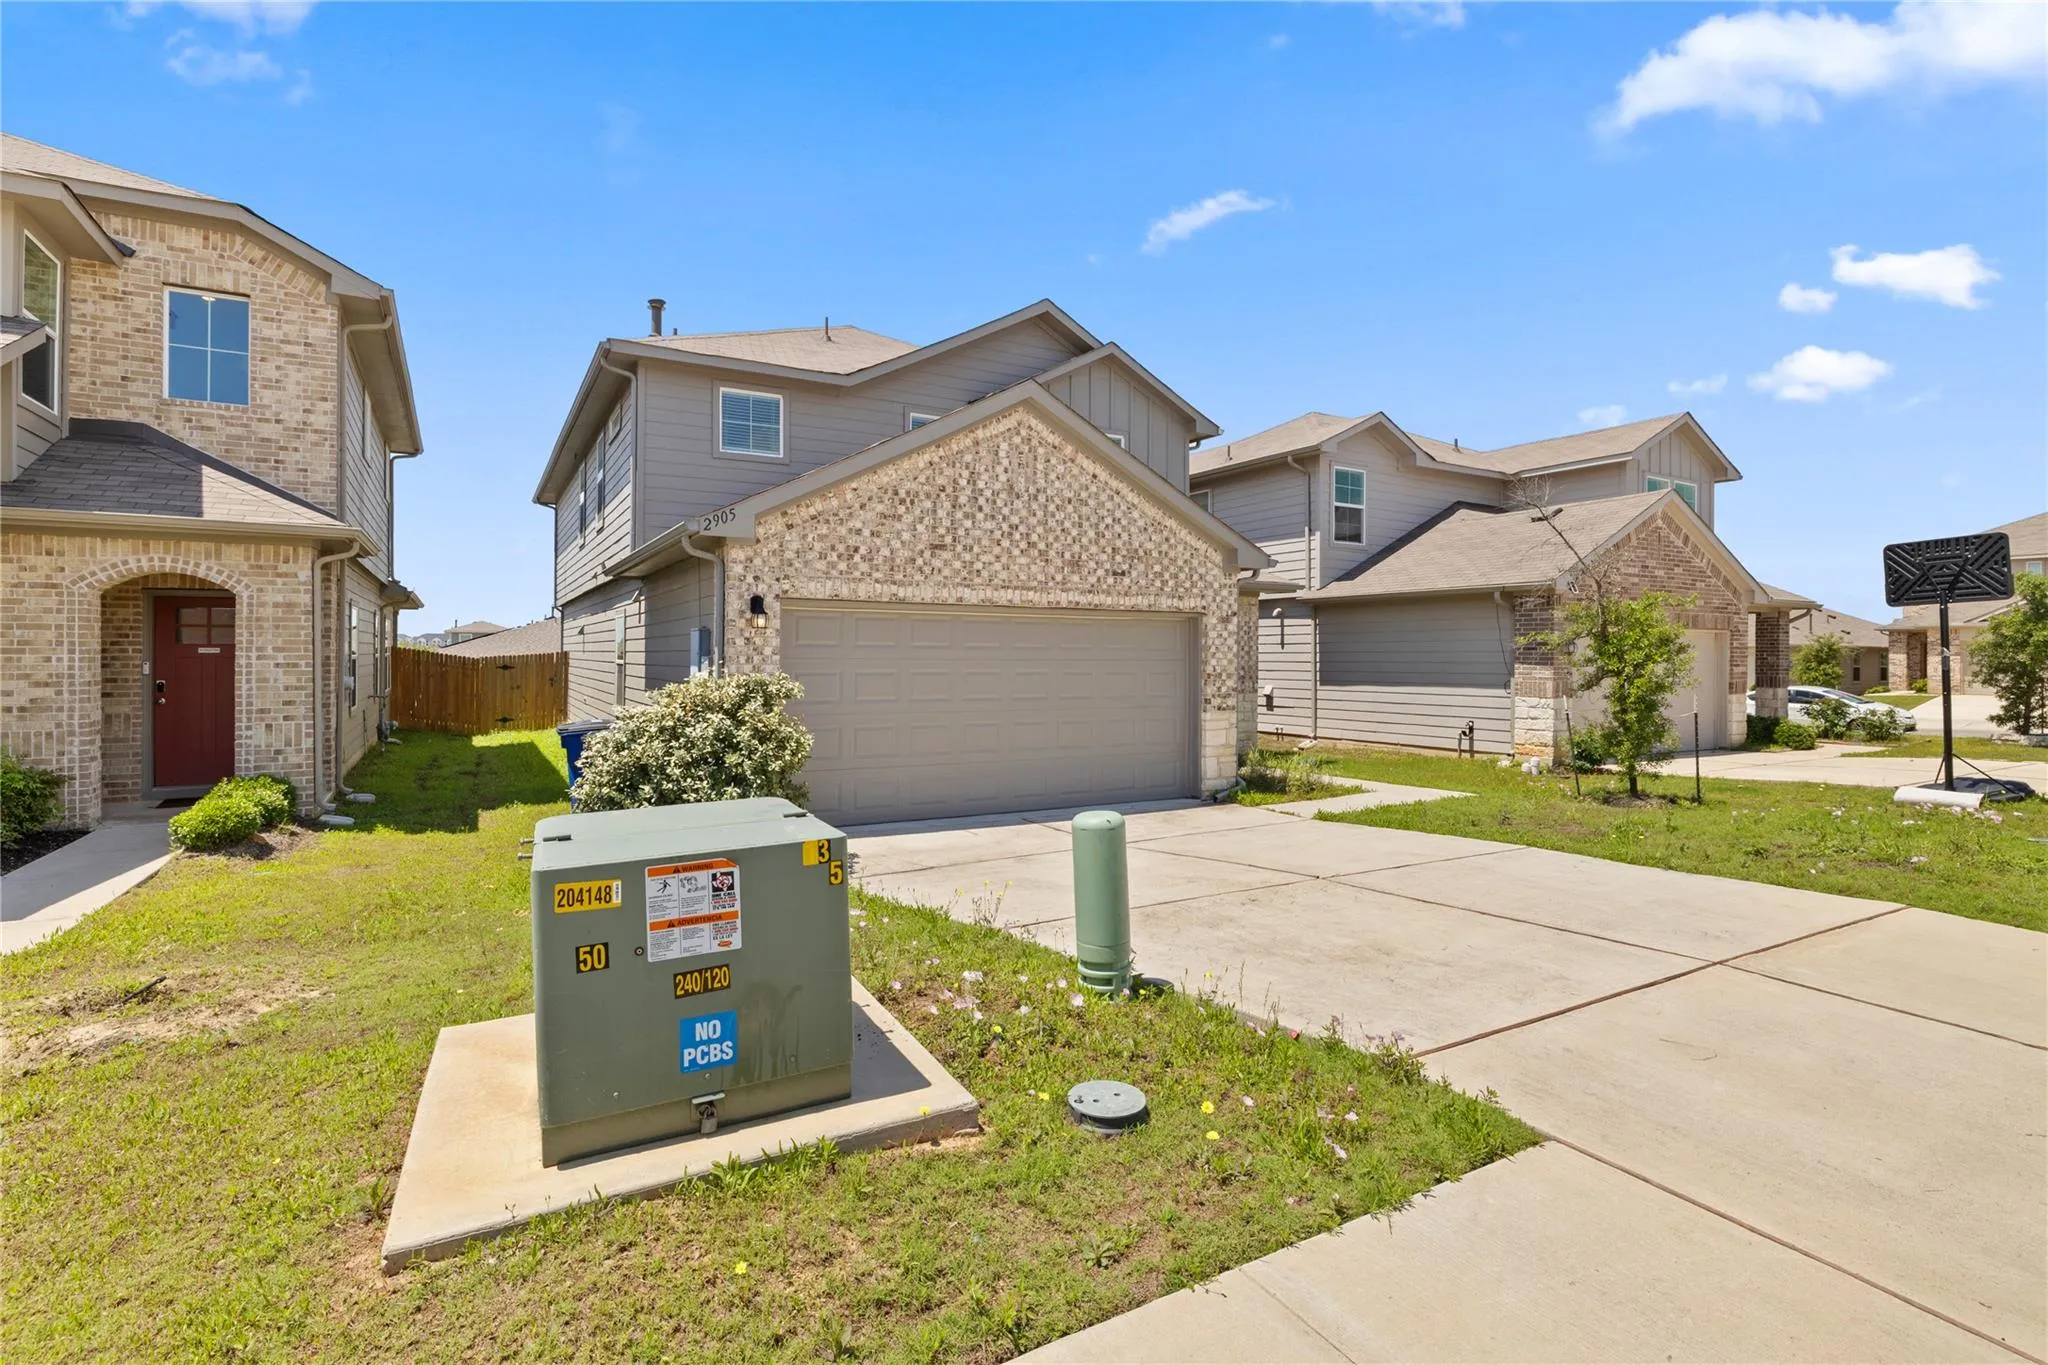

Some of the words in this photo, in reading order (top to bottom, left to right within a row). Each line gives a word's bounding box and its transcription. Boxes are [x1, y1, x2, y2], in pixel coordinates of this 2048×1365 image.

[703, 507, 736, 531] 2905
[818, 839, 830, 863] 3
[682, 863, 714, 873] WARNING
[830, 861, 843, 885] 5
[557, 884, 612, 908] 204148
[677, 914, 723, 926] ADVERTENCIA
[579, 945, 607, 972] 50
[675, 968, 730, 995] 240/120
[695, 1019, 722, 1042] NO
[683, 1041, 734, 1067] PCBS
